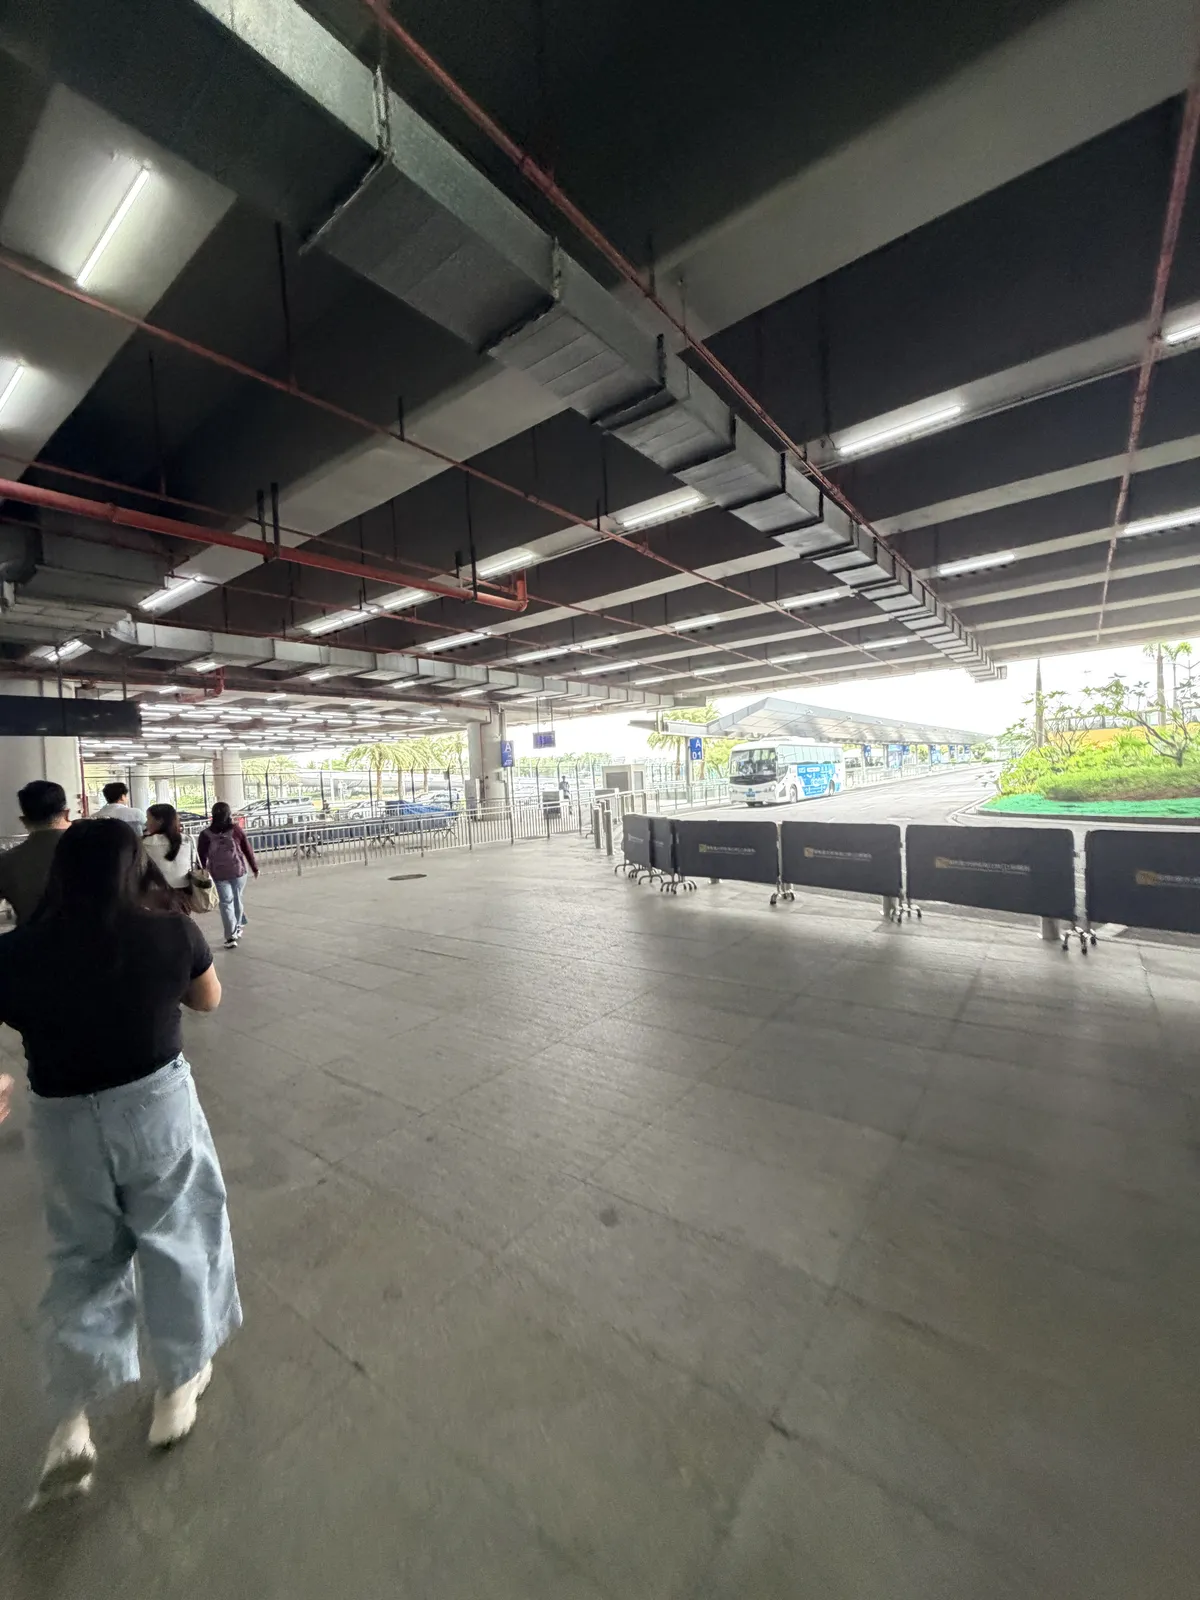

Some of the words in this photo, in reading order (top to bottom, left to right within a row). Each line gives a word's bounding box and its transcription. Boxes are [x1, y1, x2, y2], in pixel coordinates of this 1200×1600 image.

[505, 741, 512, 752] A
[695, 739, 701, 748] A
[692, 751, 701, 759] 01
